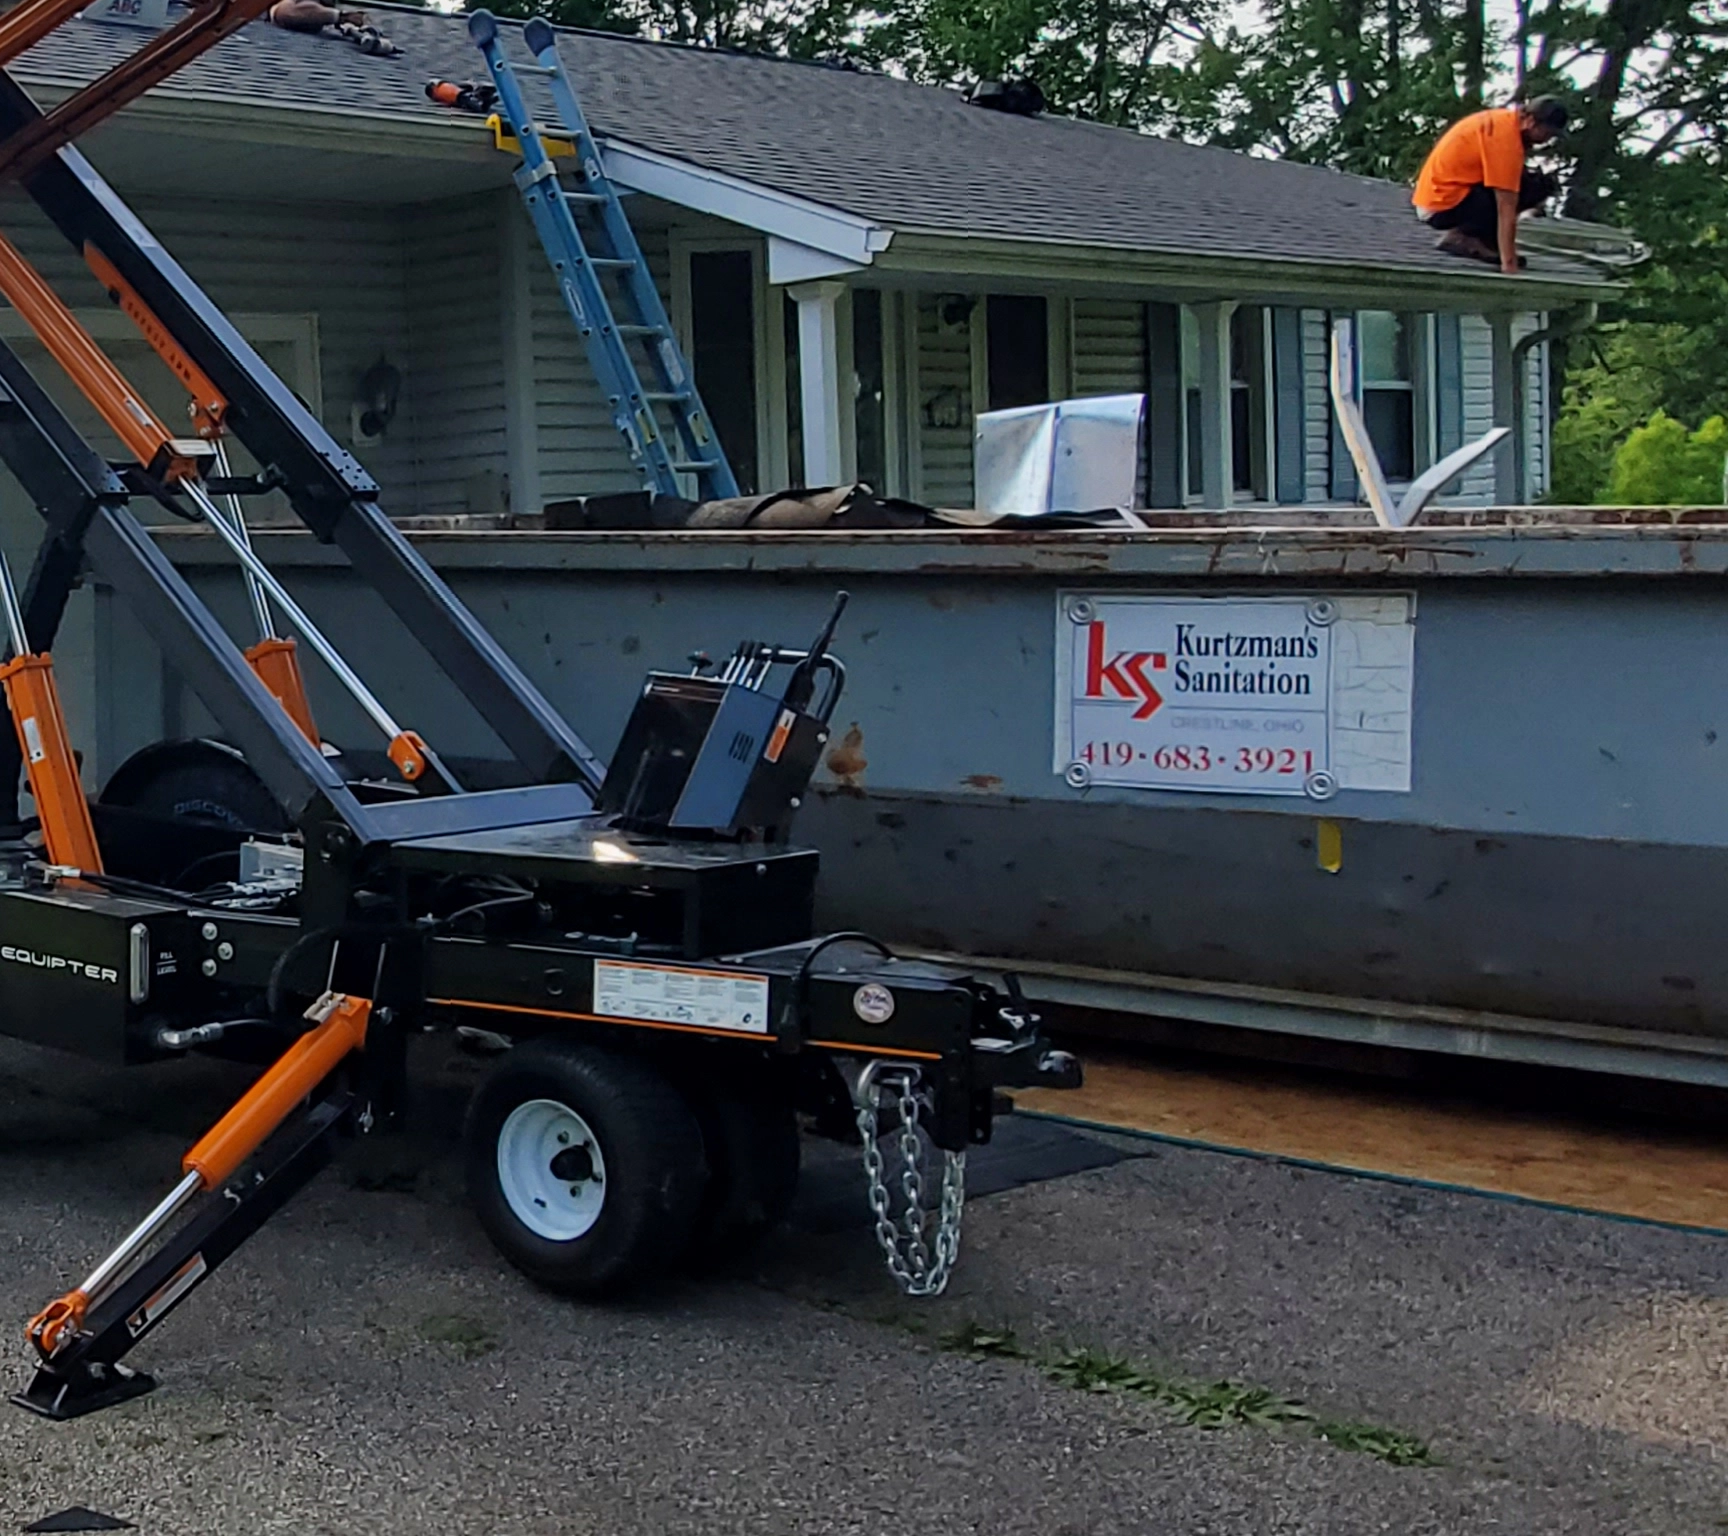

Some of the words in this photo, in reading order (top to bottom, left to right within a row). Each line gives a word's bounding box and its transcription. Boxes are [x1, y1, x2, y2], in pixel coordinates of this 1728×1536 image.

[1175, 623, 1319, 659] Kurtzman's
[1175, 660, 1311, 695] Sanitation
[1, 946, 118, 983] EQUIPTER
